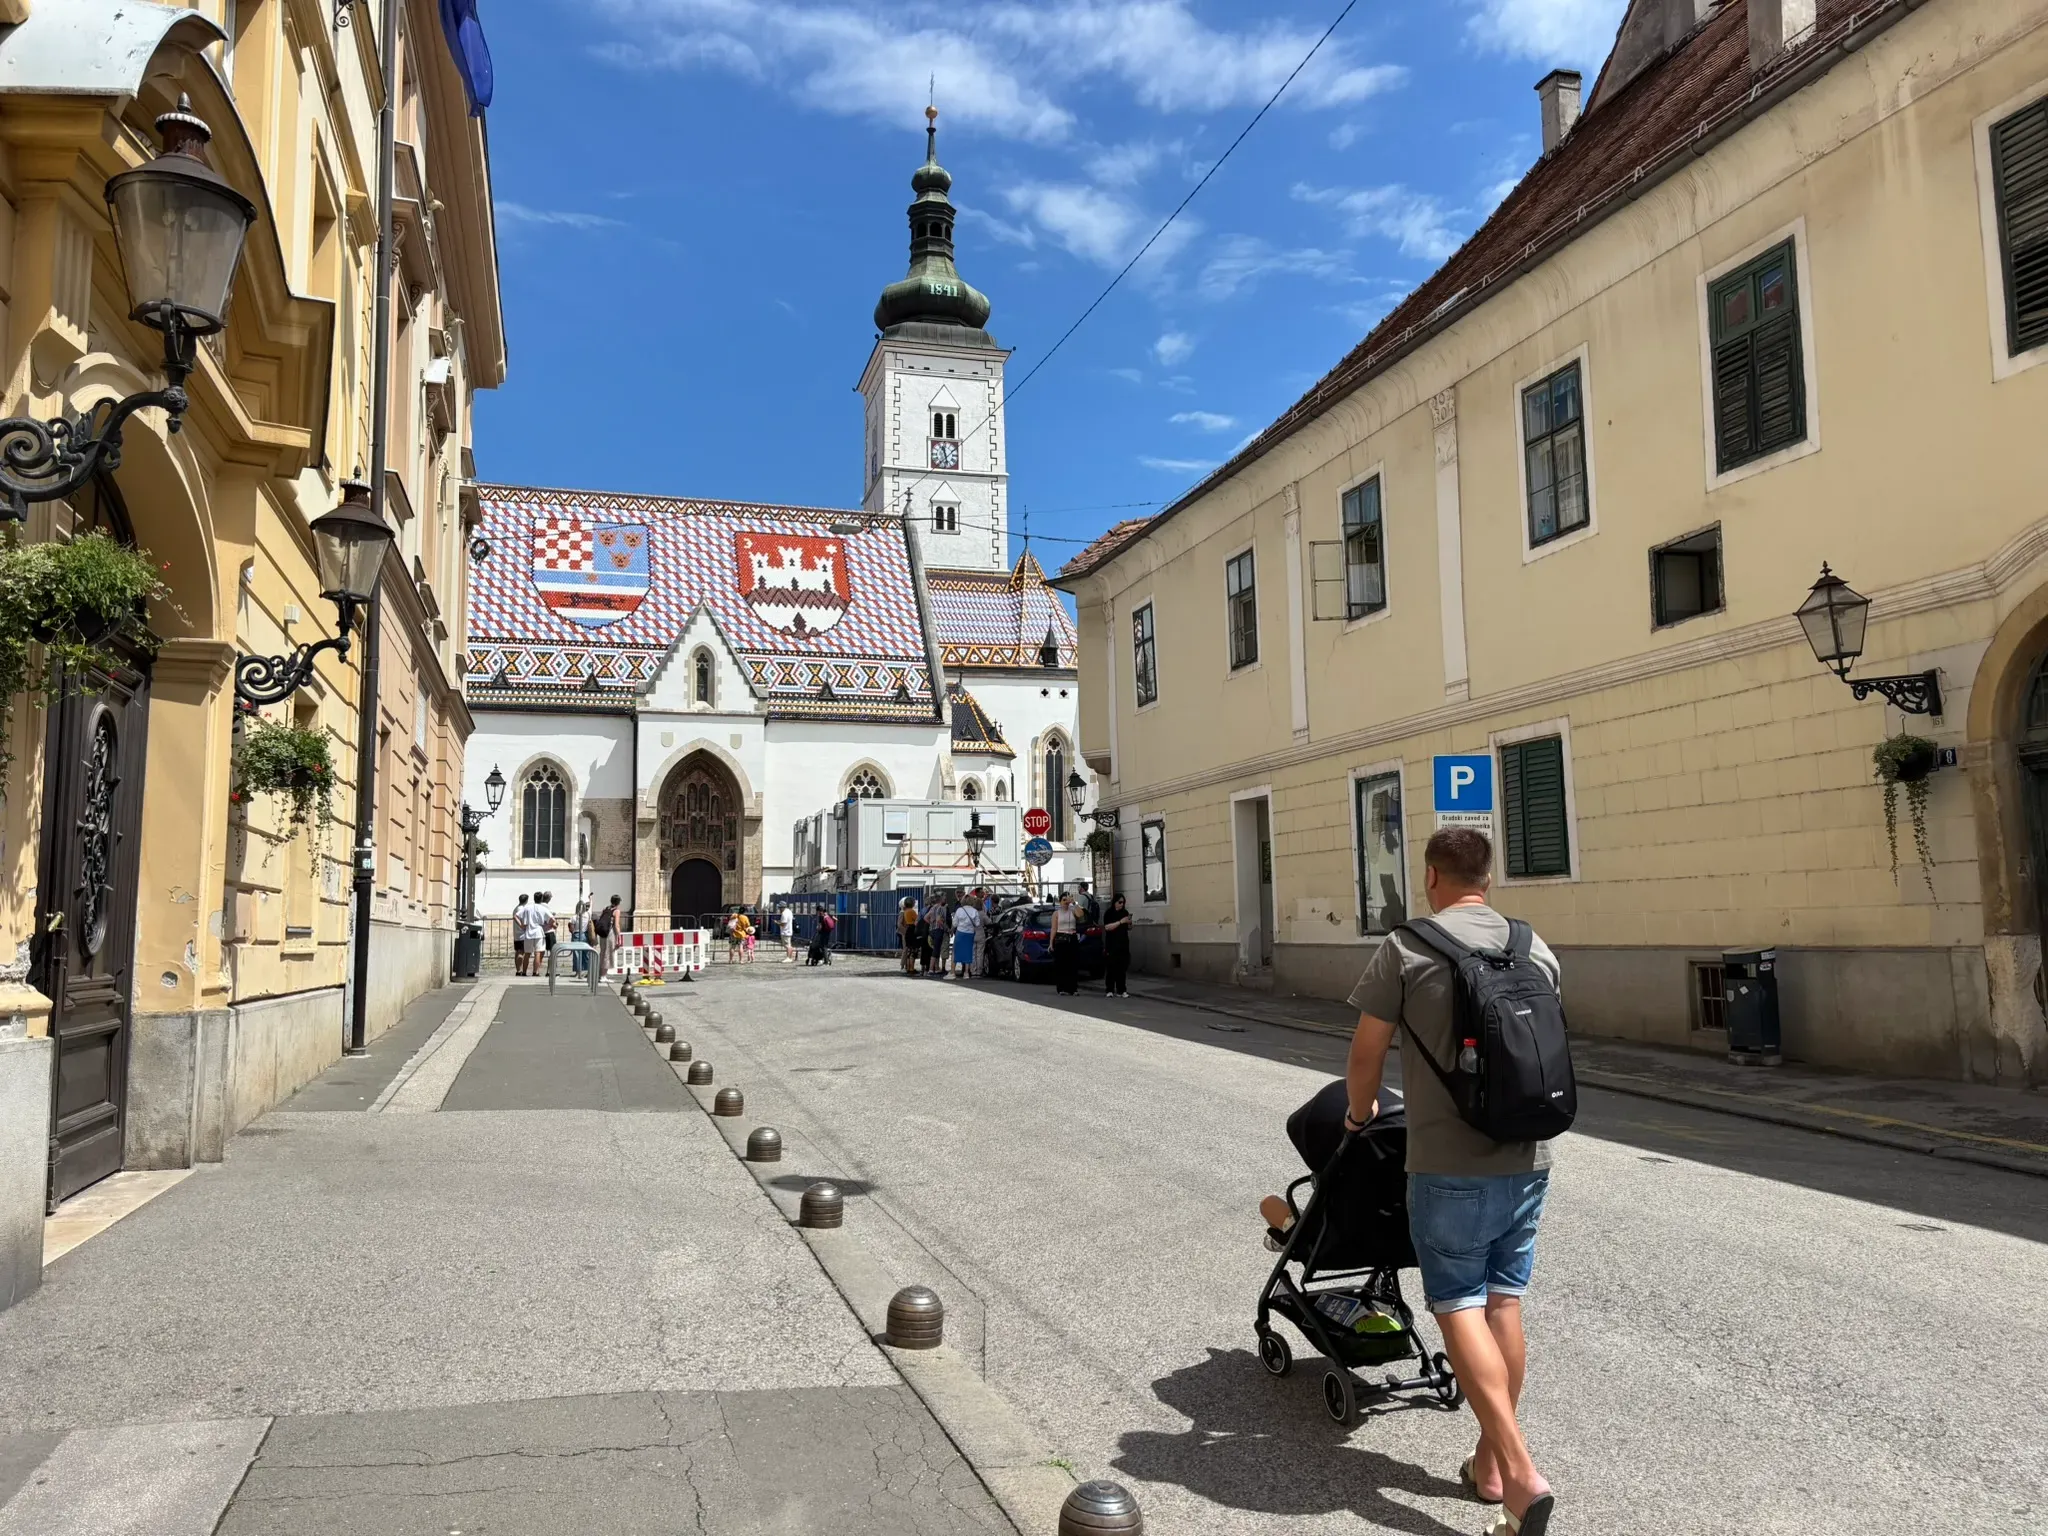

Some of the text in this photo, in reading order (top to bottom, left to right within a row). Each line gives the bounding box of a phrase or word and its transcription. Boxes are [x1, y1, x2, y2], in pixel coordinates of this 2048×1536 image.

[929, 283, 958, 296] 1841
[1946, 750, 1953, 763] 8
[1450, 766, 1475, 799] P
[1024, 816, 1049, 828] STOP
